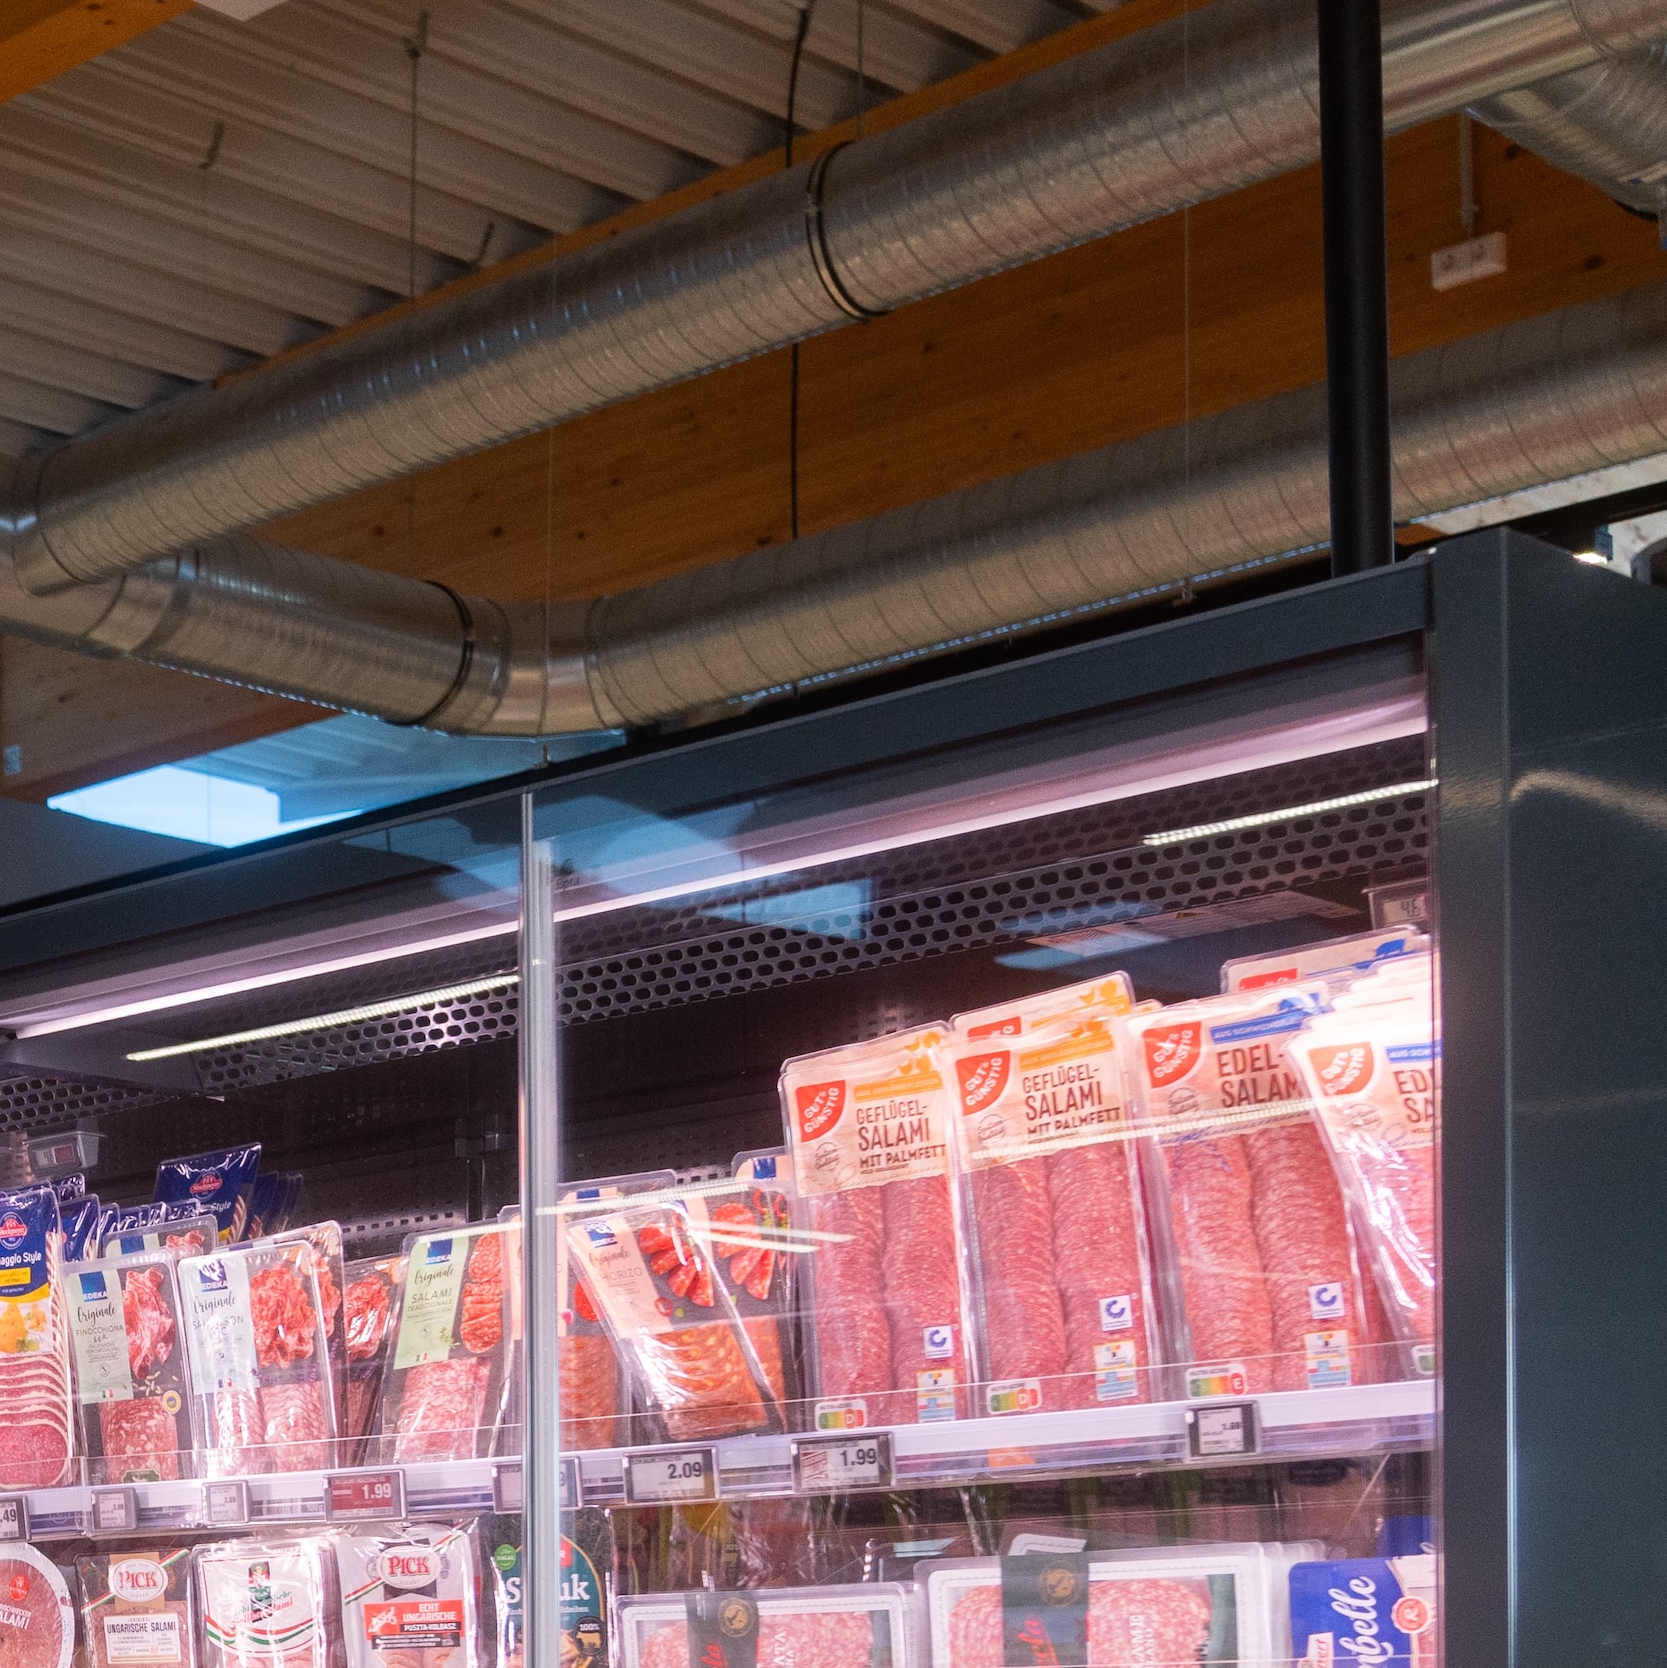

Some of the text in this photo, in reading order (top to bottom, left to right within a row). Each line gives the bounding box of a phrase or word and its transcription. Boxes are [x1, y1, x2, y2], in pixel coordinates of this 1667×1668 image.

[1153, 1030, 1194, 1078] GÜNSTIG
[965, 1056, 1003, 1106] GÜNSTIG
[1222, 1072, 1304, 1107] SALAM
[804, 1087, 840, 1134] GÜNSTIG
[1025, 1082, 1103, 1121] SALAMI
[1055, 1107, 1121, 1131] PALMFETT
[858, 1117, 930, 1151] SALAMI
[860, 1144, 946, 1169] MIT PALMFETT
[23, 1251, 42, 1263] Style
[427, 1254, 451, 1264] EDEKA
[415, 1264, 454, 1287] Originale
[203, 1280, 228, 1291] EDEKA
[83, 1292, 109, 1301] EDEKA
[412, 1288, 451, 1304] SALAMI
[77, 1302, 116, 1327] Originale
[76, 1325, 124, 1336] FINOCCHIONA
[839, 1448, 877, 1467] 1.99
[668, 1462, 703, 1478] 2.09
[362, 1484, 392, 1500] 1.99
[388, 1555, 431, 1576] PICK
[118, 1571, 158, 1590] PICK
[506, 1574, 591, 1602] Suk
[402, 1611, 456, 1622] UNGARISCHE
[418, 1603, 439, 1612] ECHT
[106, 1620, 177, 1634] UNGARISCHE SALAMI
[579, 1623, 599, 1631] 100%
